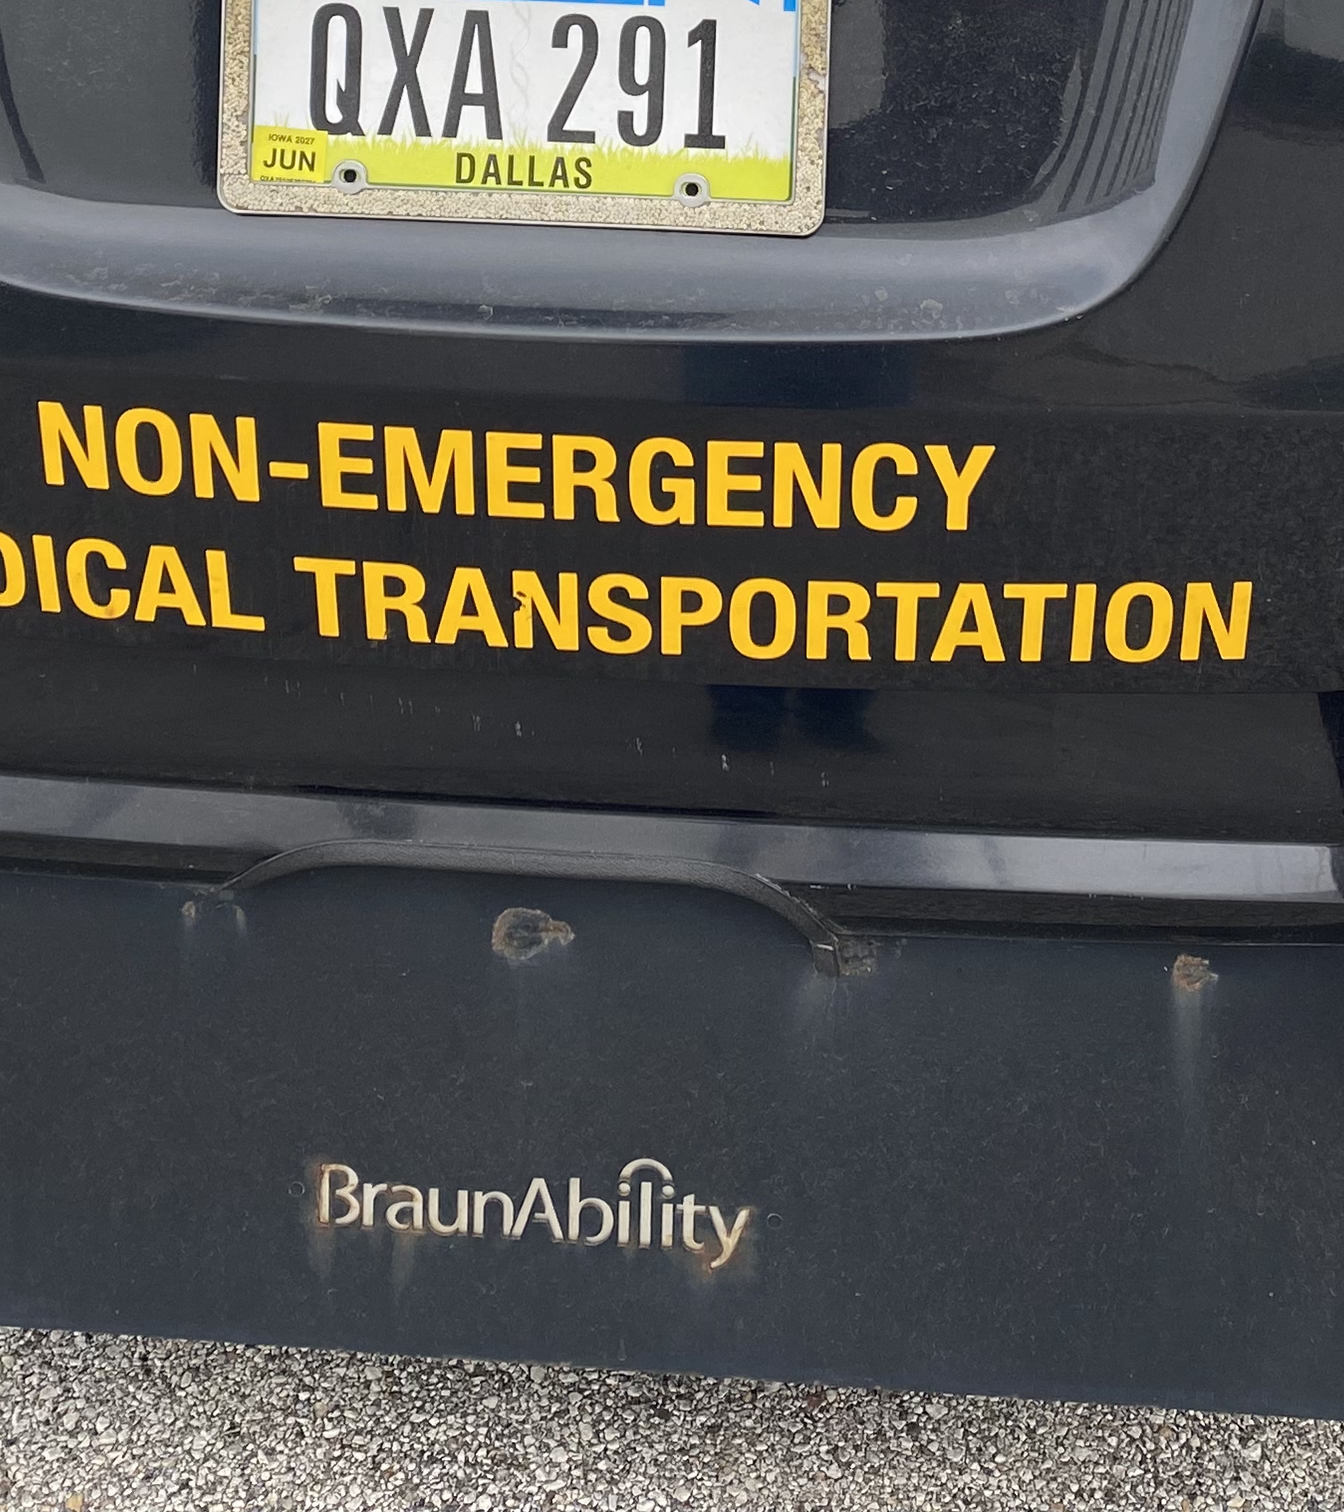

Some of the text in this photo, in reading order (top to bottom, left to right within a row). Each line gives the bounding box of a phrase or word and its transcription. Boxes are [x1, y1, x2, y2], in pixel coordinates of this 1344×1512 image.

[309, 2, 726, 150] QXA 291
[262, 147, 316, 172] JUN
[268, 133, 315, 145] IOWA 2027
[456, 152, 593, 190] DALLAS
[37, 400, 996, 532] NON-EMERGENCY
[294, 555, 1253, 662] TRANSPORTATION
[318, 1157, 752, 1271] BraunAbility
